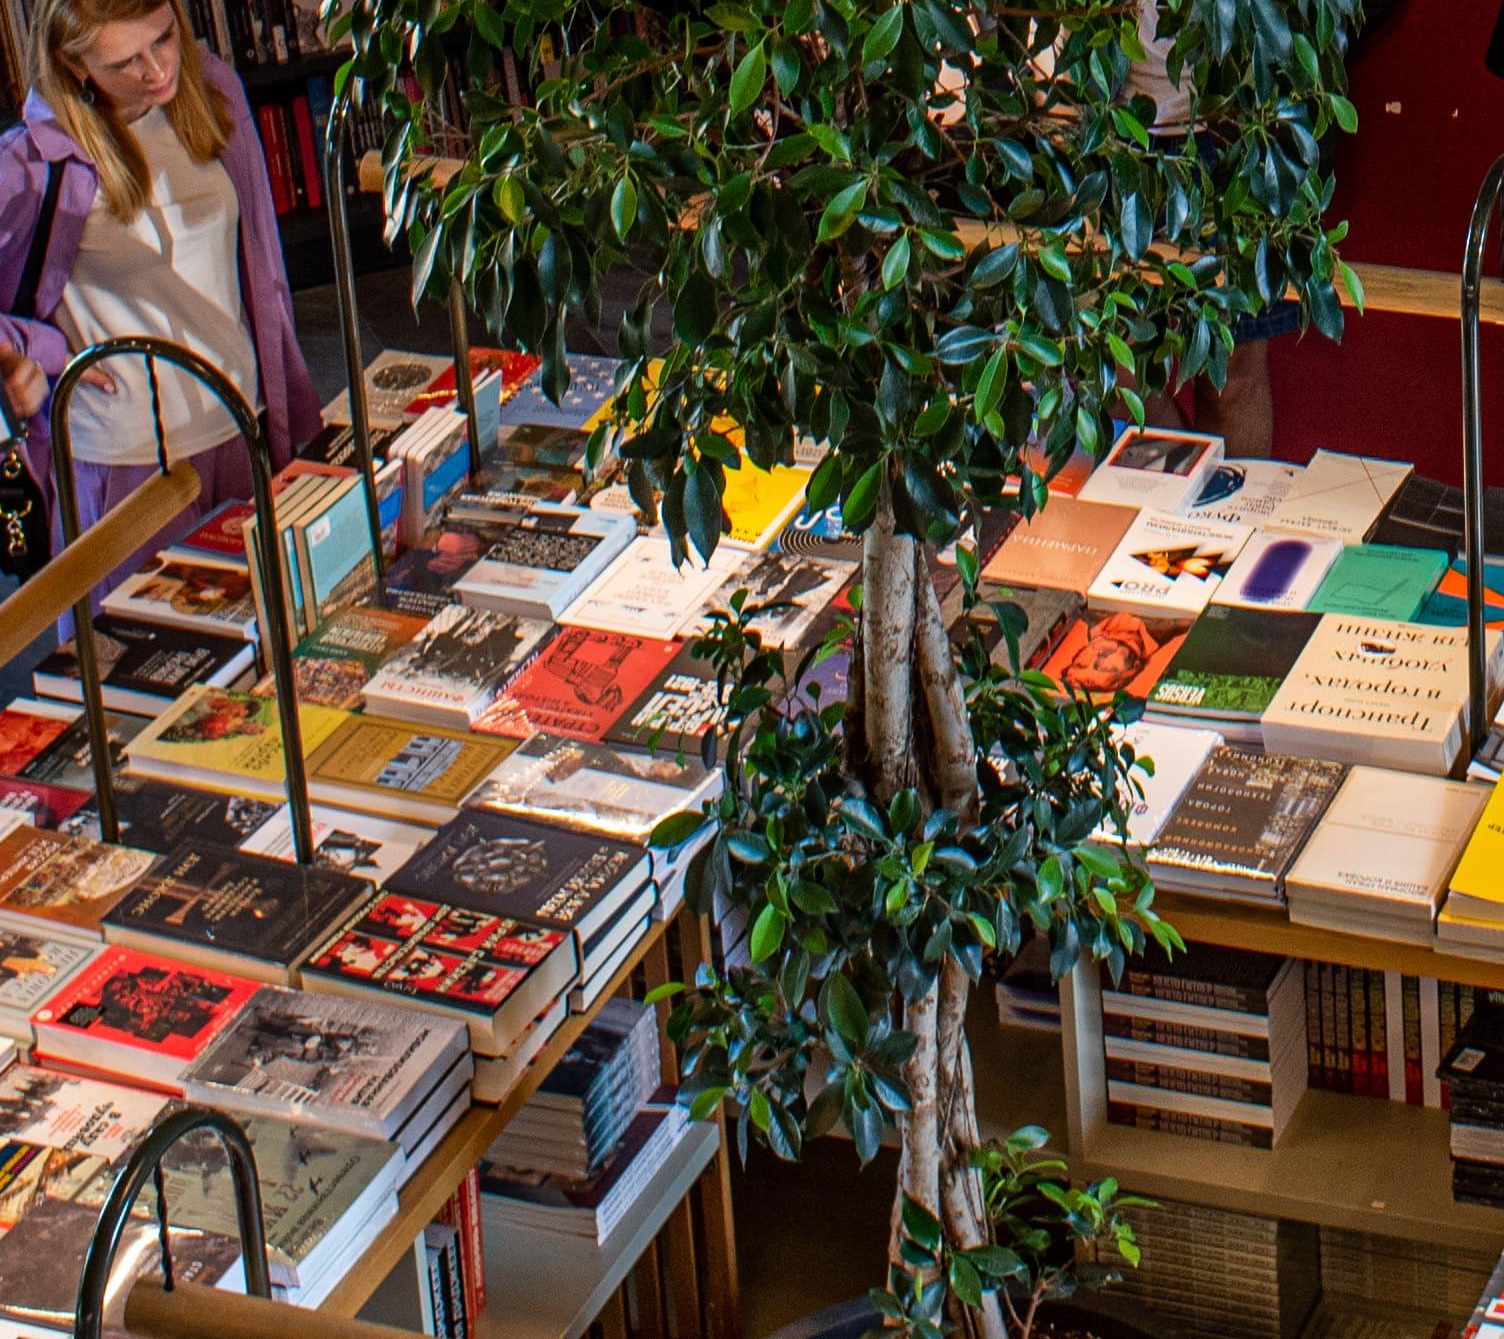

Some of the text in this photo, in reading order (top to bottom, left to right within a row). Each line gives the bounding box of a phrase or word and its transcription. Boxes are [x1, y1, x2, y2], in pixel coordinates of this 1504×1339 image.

[1336, 623, 1423, 645] жизни
[1332, 649, 1450, 673] удобных
[1155, 684, 1207, 706] VERSUS
[1284, 700, 1433, 734] Транспорт
